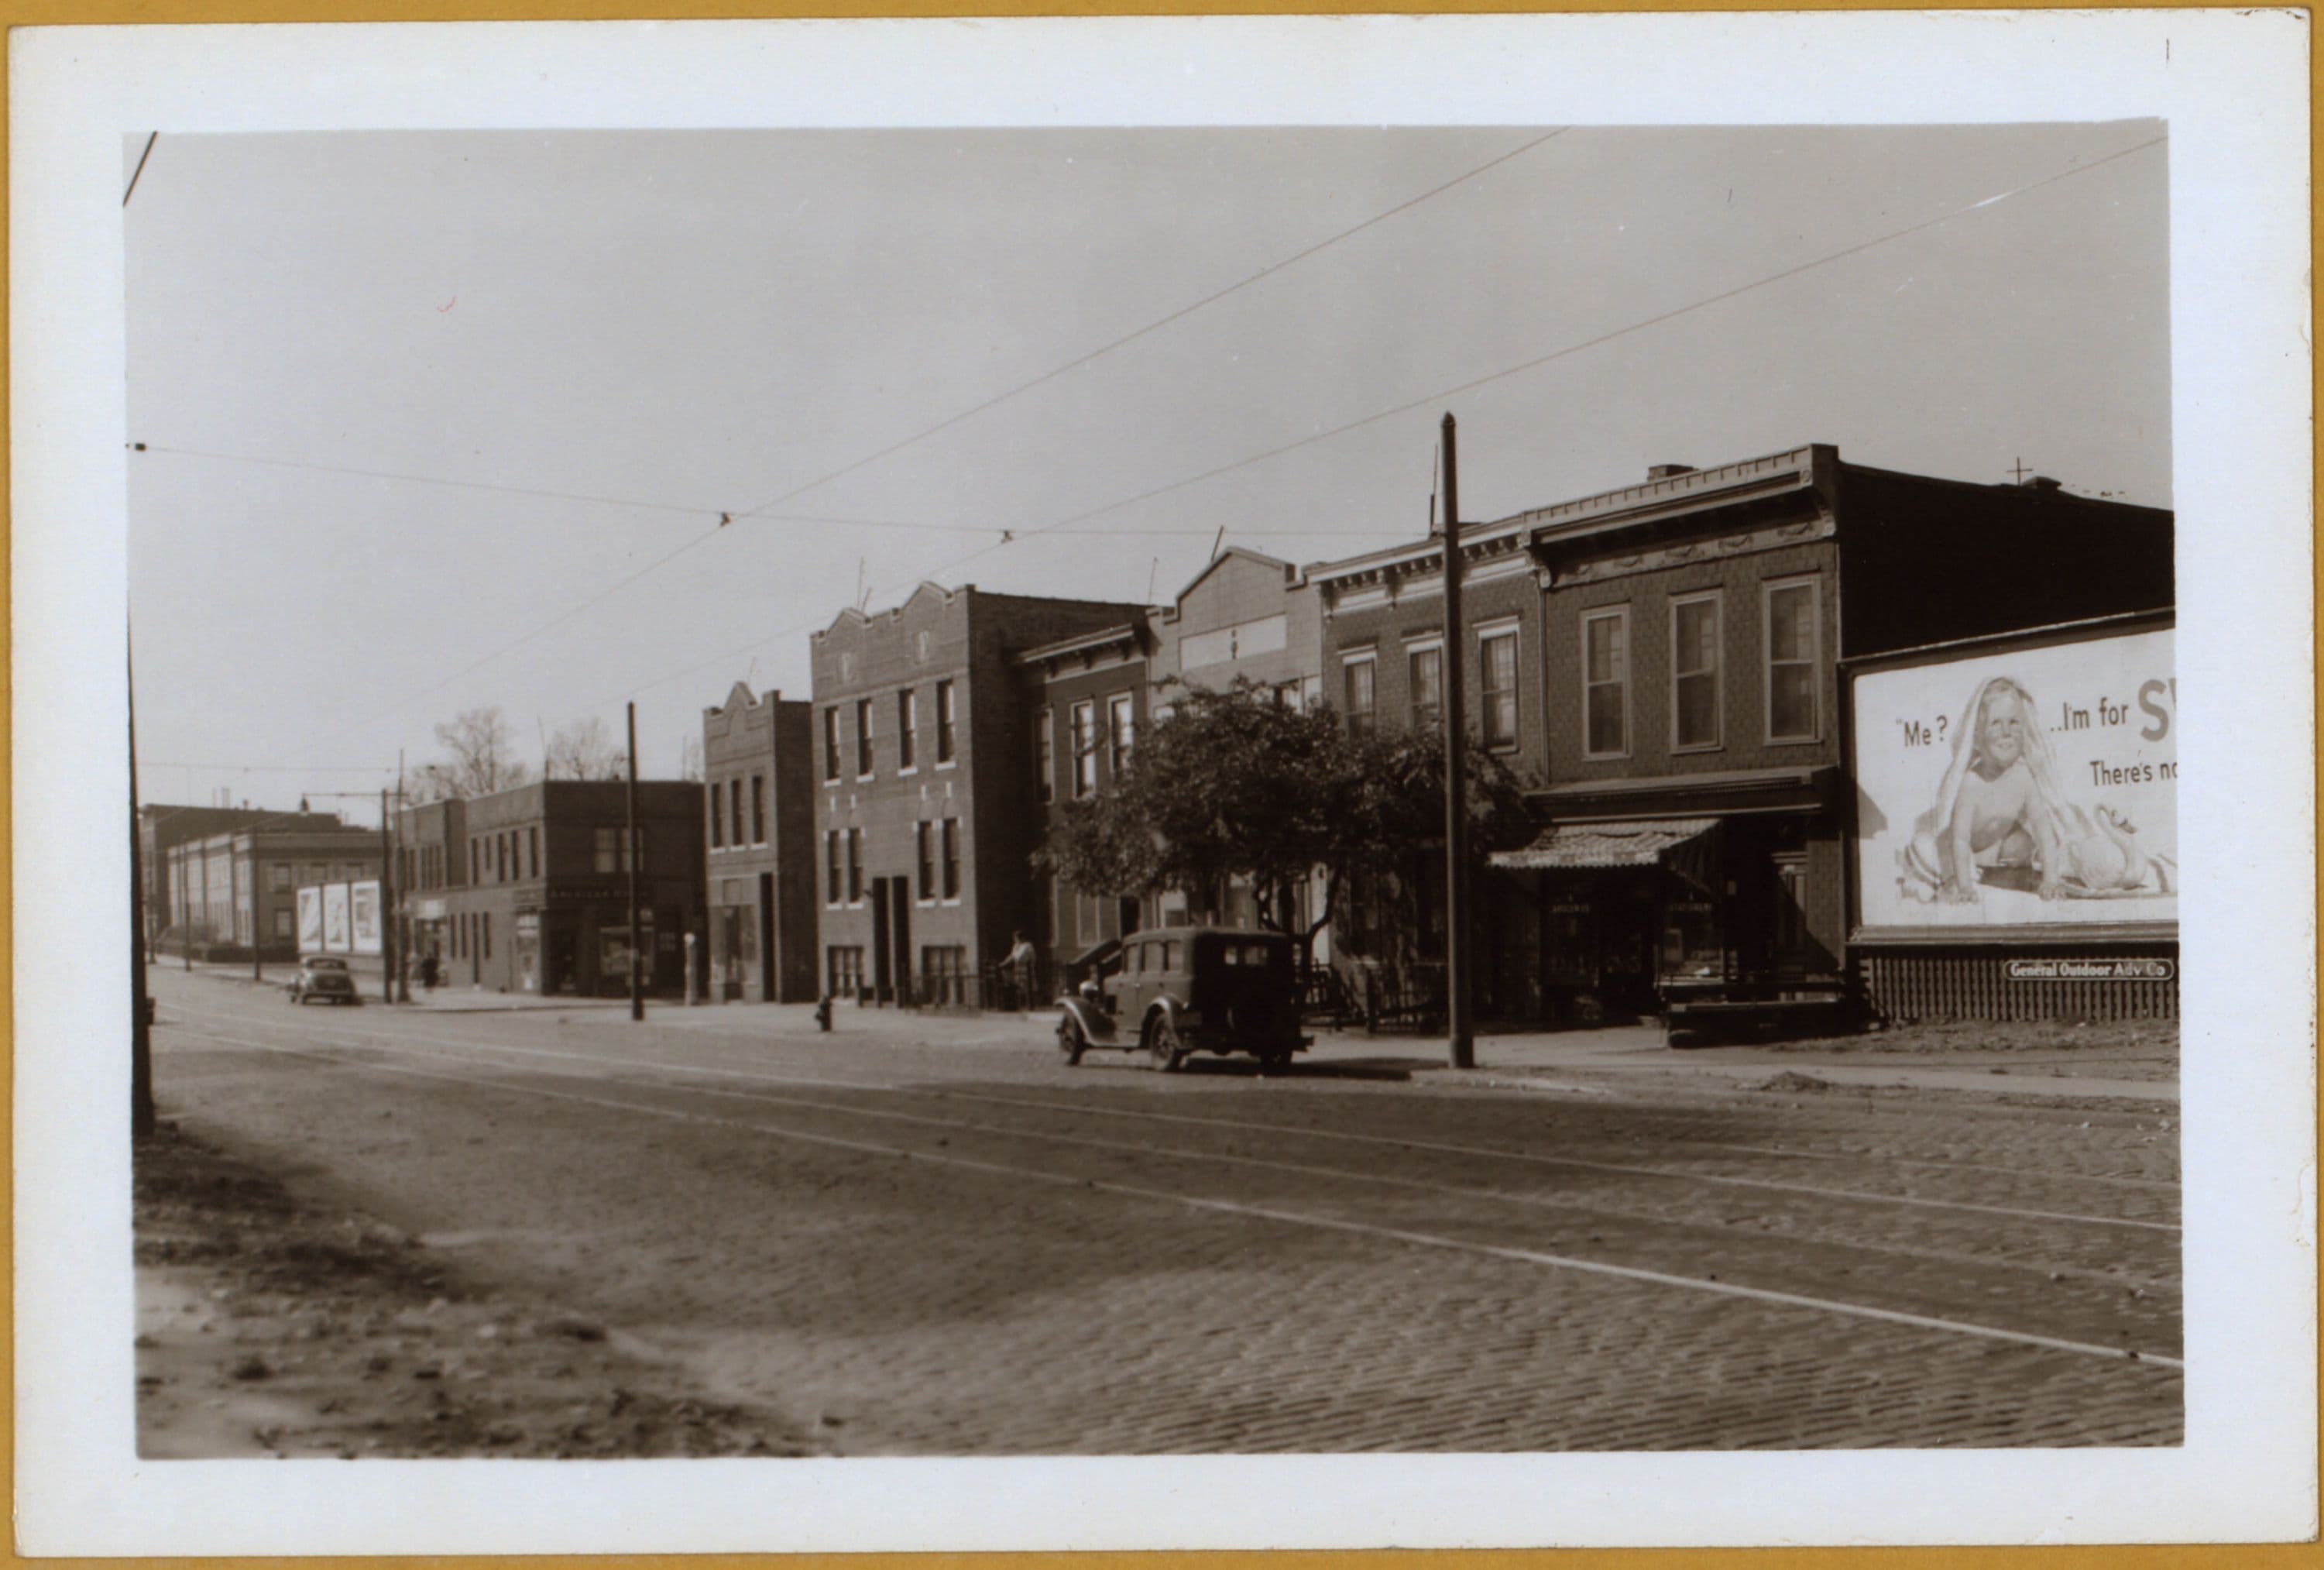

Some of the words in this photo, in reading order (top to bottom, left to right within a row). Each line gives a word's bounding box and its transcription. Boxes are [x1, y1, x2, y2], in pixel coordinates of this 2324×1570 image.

[2099, 697, 2129, 727] for
[2138, 678, 2176, 742] S
[2090, 760, 2153, 786] There's
[2010, 963, 2057, 977] General
[2059, 963, 2111, 977] Outdoor
[2147, 963, 2166, 977] Co
